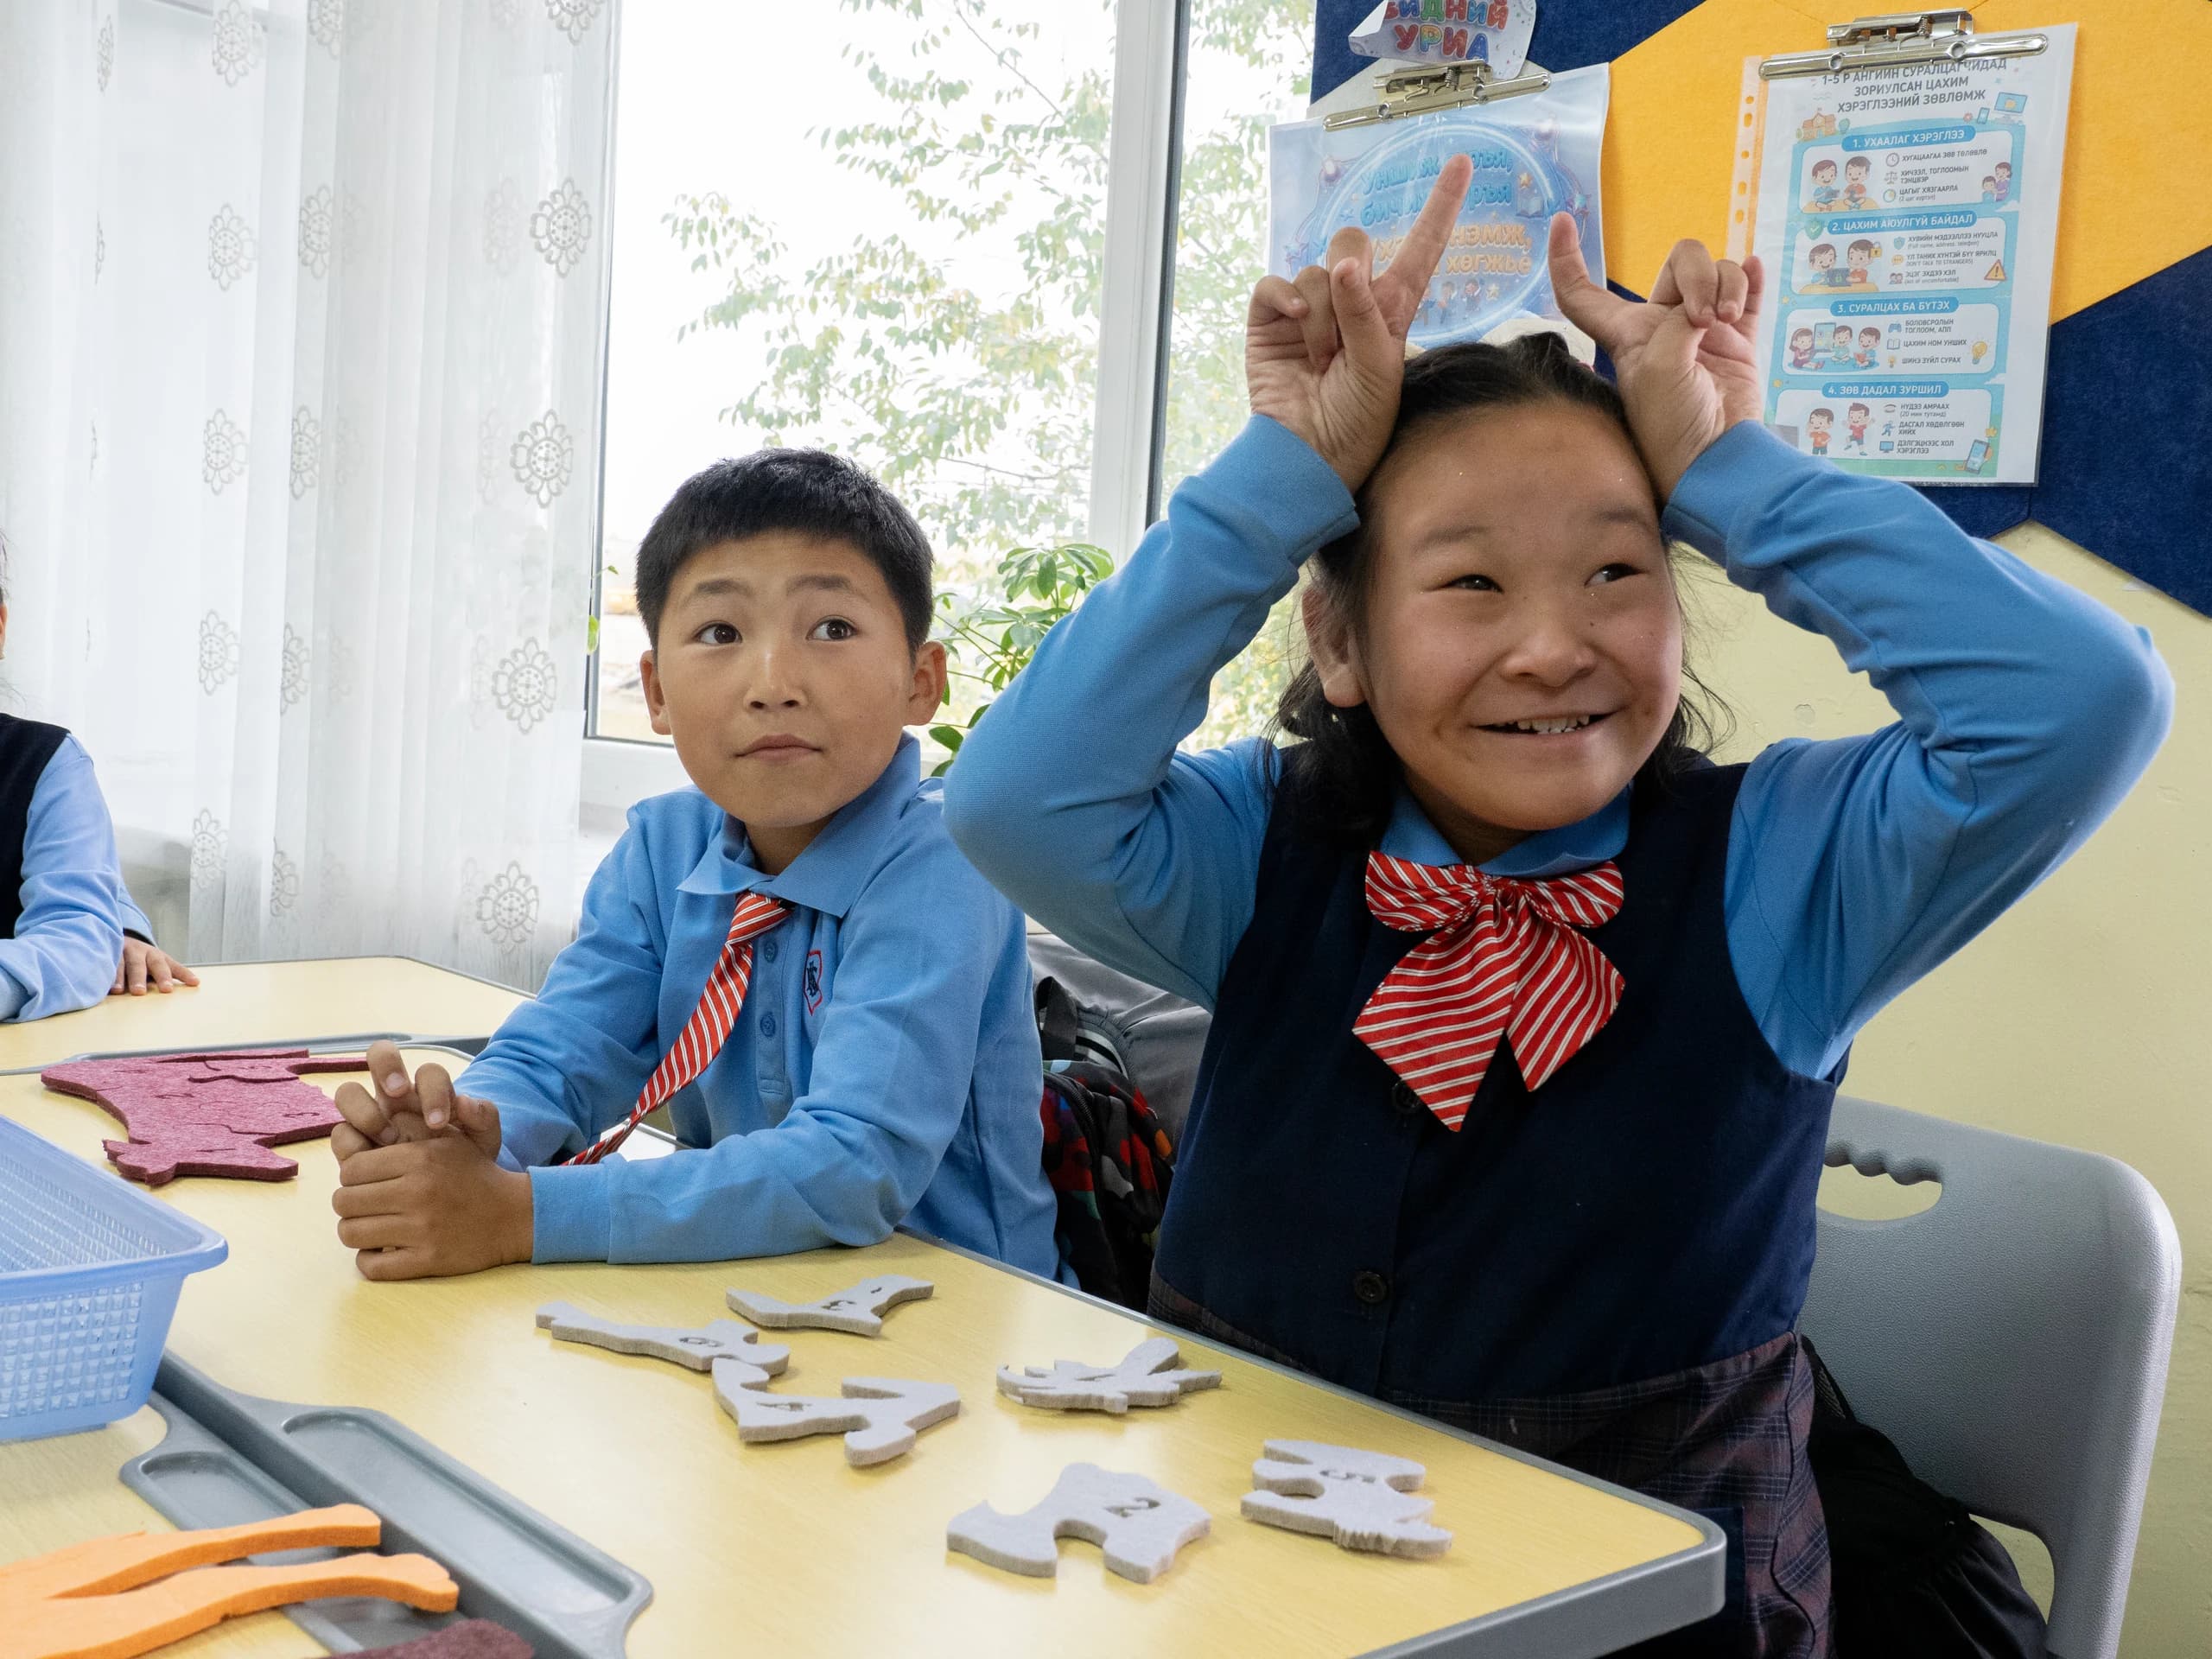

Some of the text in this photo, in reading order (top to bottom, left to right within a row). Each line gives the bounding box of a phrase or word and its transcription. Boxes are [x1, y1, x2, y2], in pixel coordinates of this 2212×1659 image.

[1822, 72, 1840, 85] 1-5
[1853, 67, 1899, 83] АНГИИН
[1853, 75, 1969, 97] ЗОРИУЛСАН ЦАХИМ
[1837, 89, 1986, 113] ХЭРЭГЛЭЭНИЙ ЗӨВЛӨМЖ
[1853, 130, 1965, 148] 1. УХААЛАГ ХЭРЭГЛЭЭ
[1902, 152, 1942, 162] ХУГАЦААГАА
[1929, 165, 1969, 175] ТОГЛООМЫН
[1831, 221, 1840, 232] 2.
[1843, 219, 1879, 232] ЦАХИМ
[1930, 213, 1974, 226] БАЙДАЛ
[1838, 303, 1847, 313] 3.
[1849, 302, 1900, 314] СУРАЛЦАХ
[1902, 302, 1916, 311] БА
[1905, 318, 1954, 327] БОЛОВСРОЛЫН
[1943, 339, 1967, 347] УНШИХ
[1840, 385, 1859, 395] ЗӨВ
[1860, 385, 1897, 397] ДАДАЛ
[1899, 385, 1942, 395] ЗУРШИЛ
[1898, 421, 1924, 429] ДАСГАЛ
